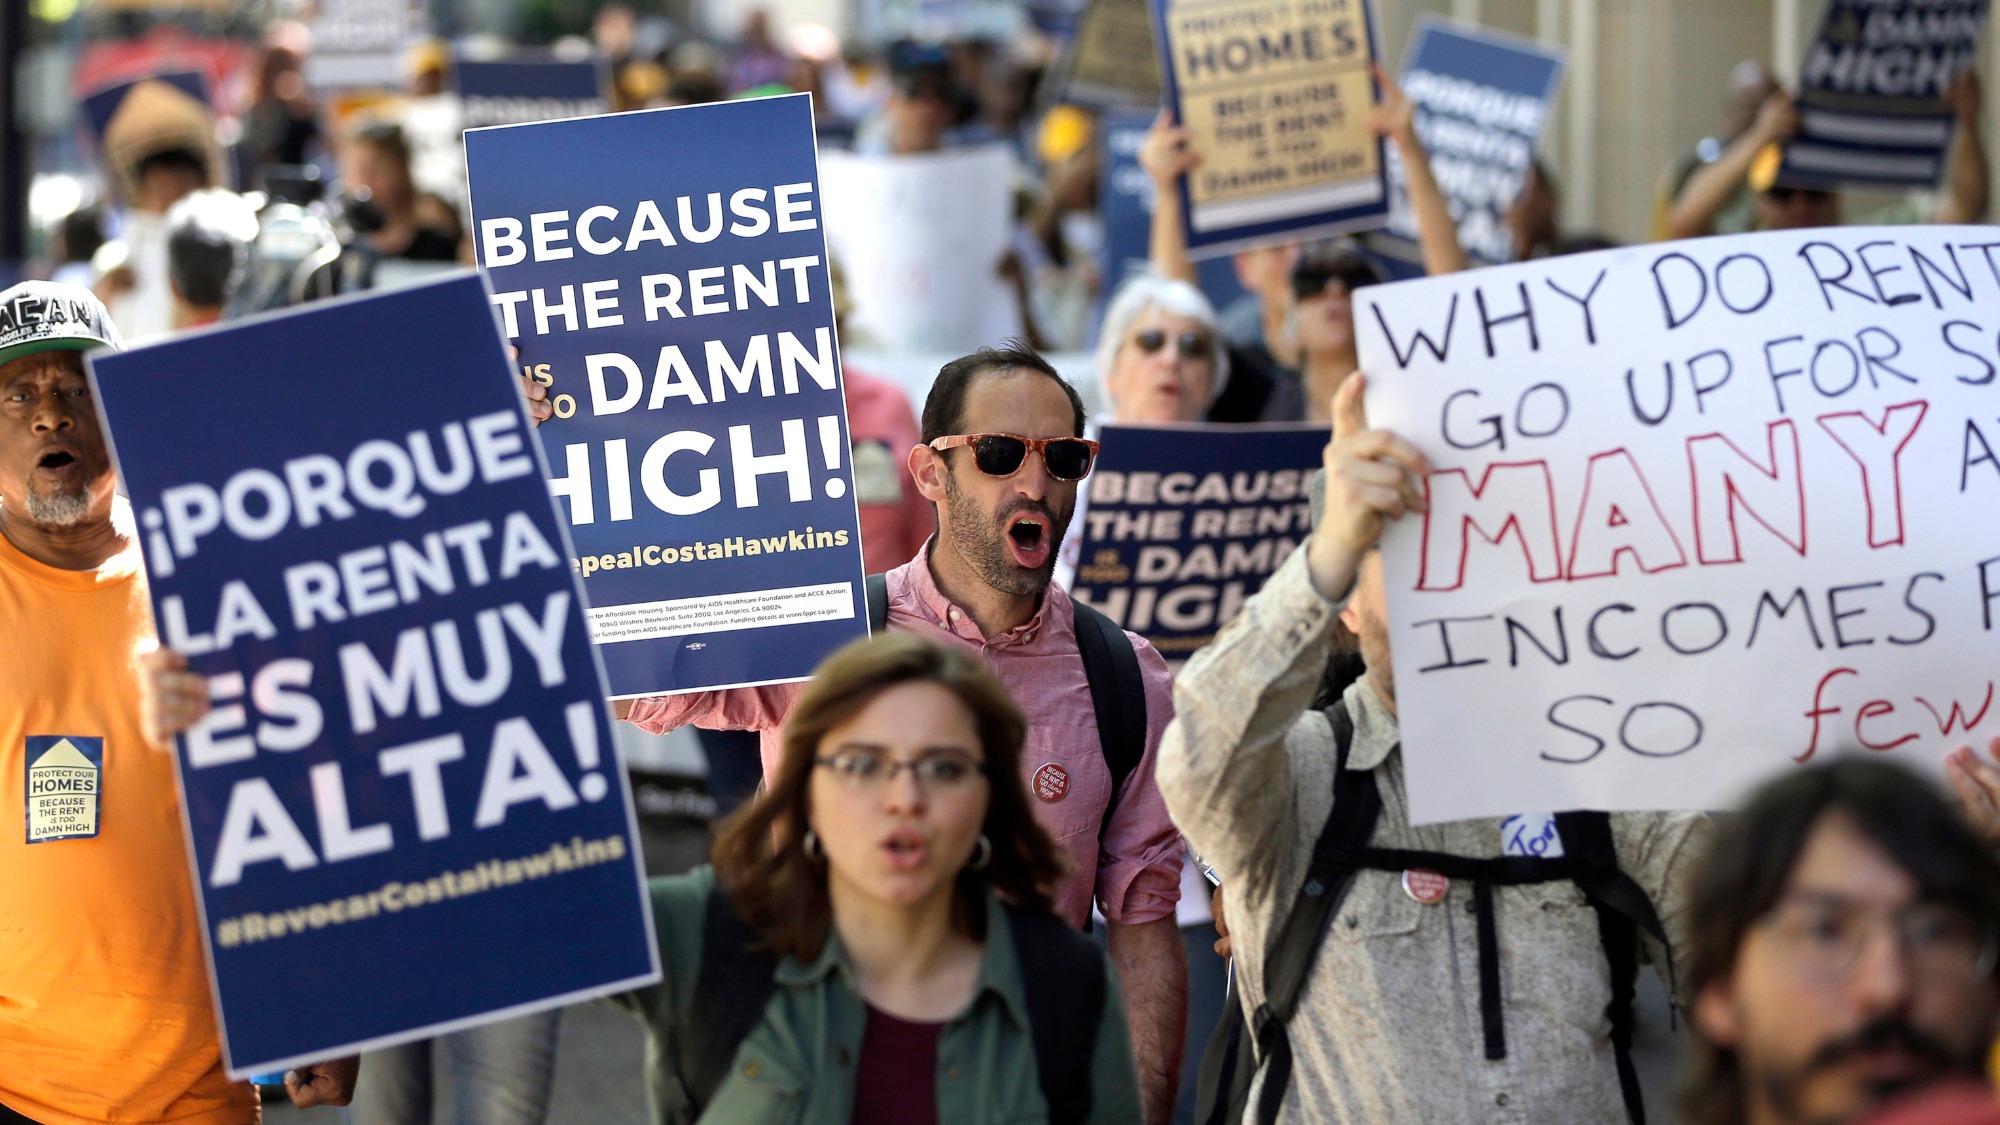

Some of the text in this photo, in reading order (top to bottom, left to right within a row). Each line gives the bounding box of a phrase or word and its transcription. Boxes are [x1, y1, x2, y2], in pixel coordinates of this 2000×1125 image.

[1184, 18, 1359, 79] HOMES
[481, 182, 818, 269] BECAUSE
[490, 254, 821, 339] THE RENT
[1370, 240, 2000, 370] WHY DO RENT
[585, 326, 838, 417] DAMN
[1440, 319, 2000, 452] GO UP FOR S
[140, 408, 536, 579] ¡PORQUE
[546, 415, 847, 526] HIGH!
[1413, 399, 1930, 593] MANY
[570, 526, 850, 578] epealCostaHawkins
[1085, 503, 1312, 541] THE RENT
[160, 510, 562, 657] LA RENTA
[601, 629, 626, 637] funding
[626, 627, 642, 635] from
[658, 622, 693, 632] Healthcare
[730, 616, 756, 625] Funding
[756, 613, 778, 622] details
[604, 610, 637, 618] Affordable
[665, 603, 698, 612] Sponsored
[723, 597, 757, 606] Healthcare
[758, 593, 793, 602] Foundation
[807, 589, 825, 597] ACCE
[619, 618, 644, 627] Wilshire
[1410, 571, 1946, 675] INCOMES
[184, 590, 573, 769] ES MUY
[1539, 667, 1995, 765] SO few
[32, 769, 95, 779] PROTECT OUR
[32, 778, 94, 794] HOMES
[38, 806, 87, 818] THE RENT
[39, 797, 86, 808] BECAUSE
[207, 700, 610, 889] ALTA!
[35, 823, 90, 836] DAMN HIGH
[215, 834, 627, 950] #RevocarCostaHawkins
